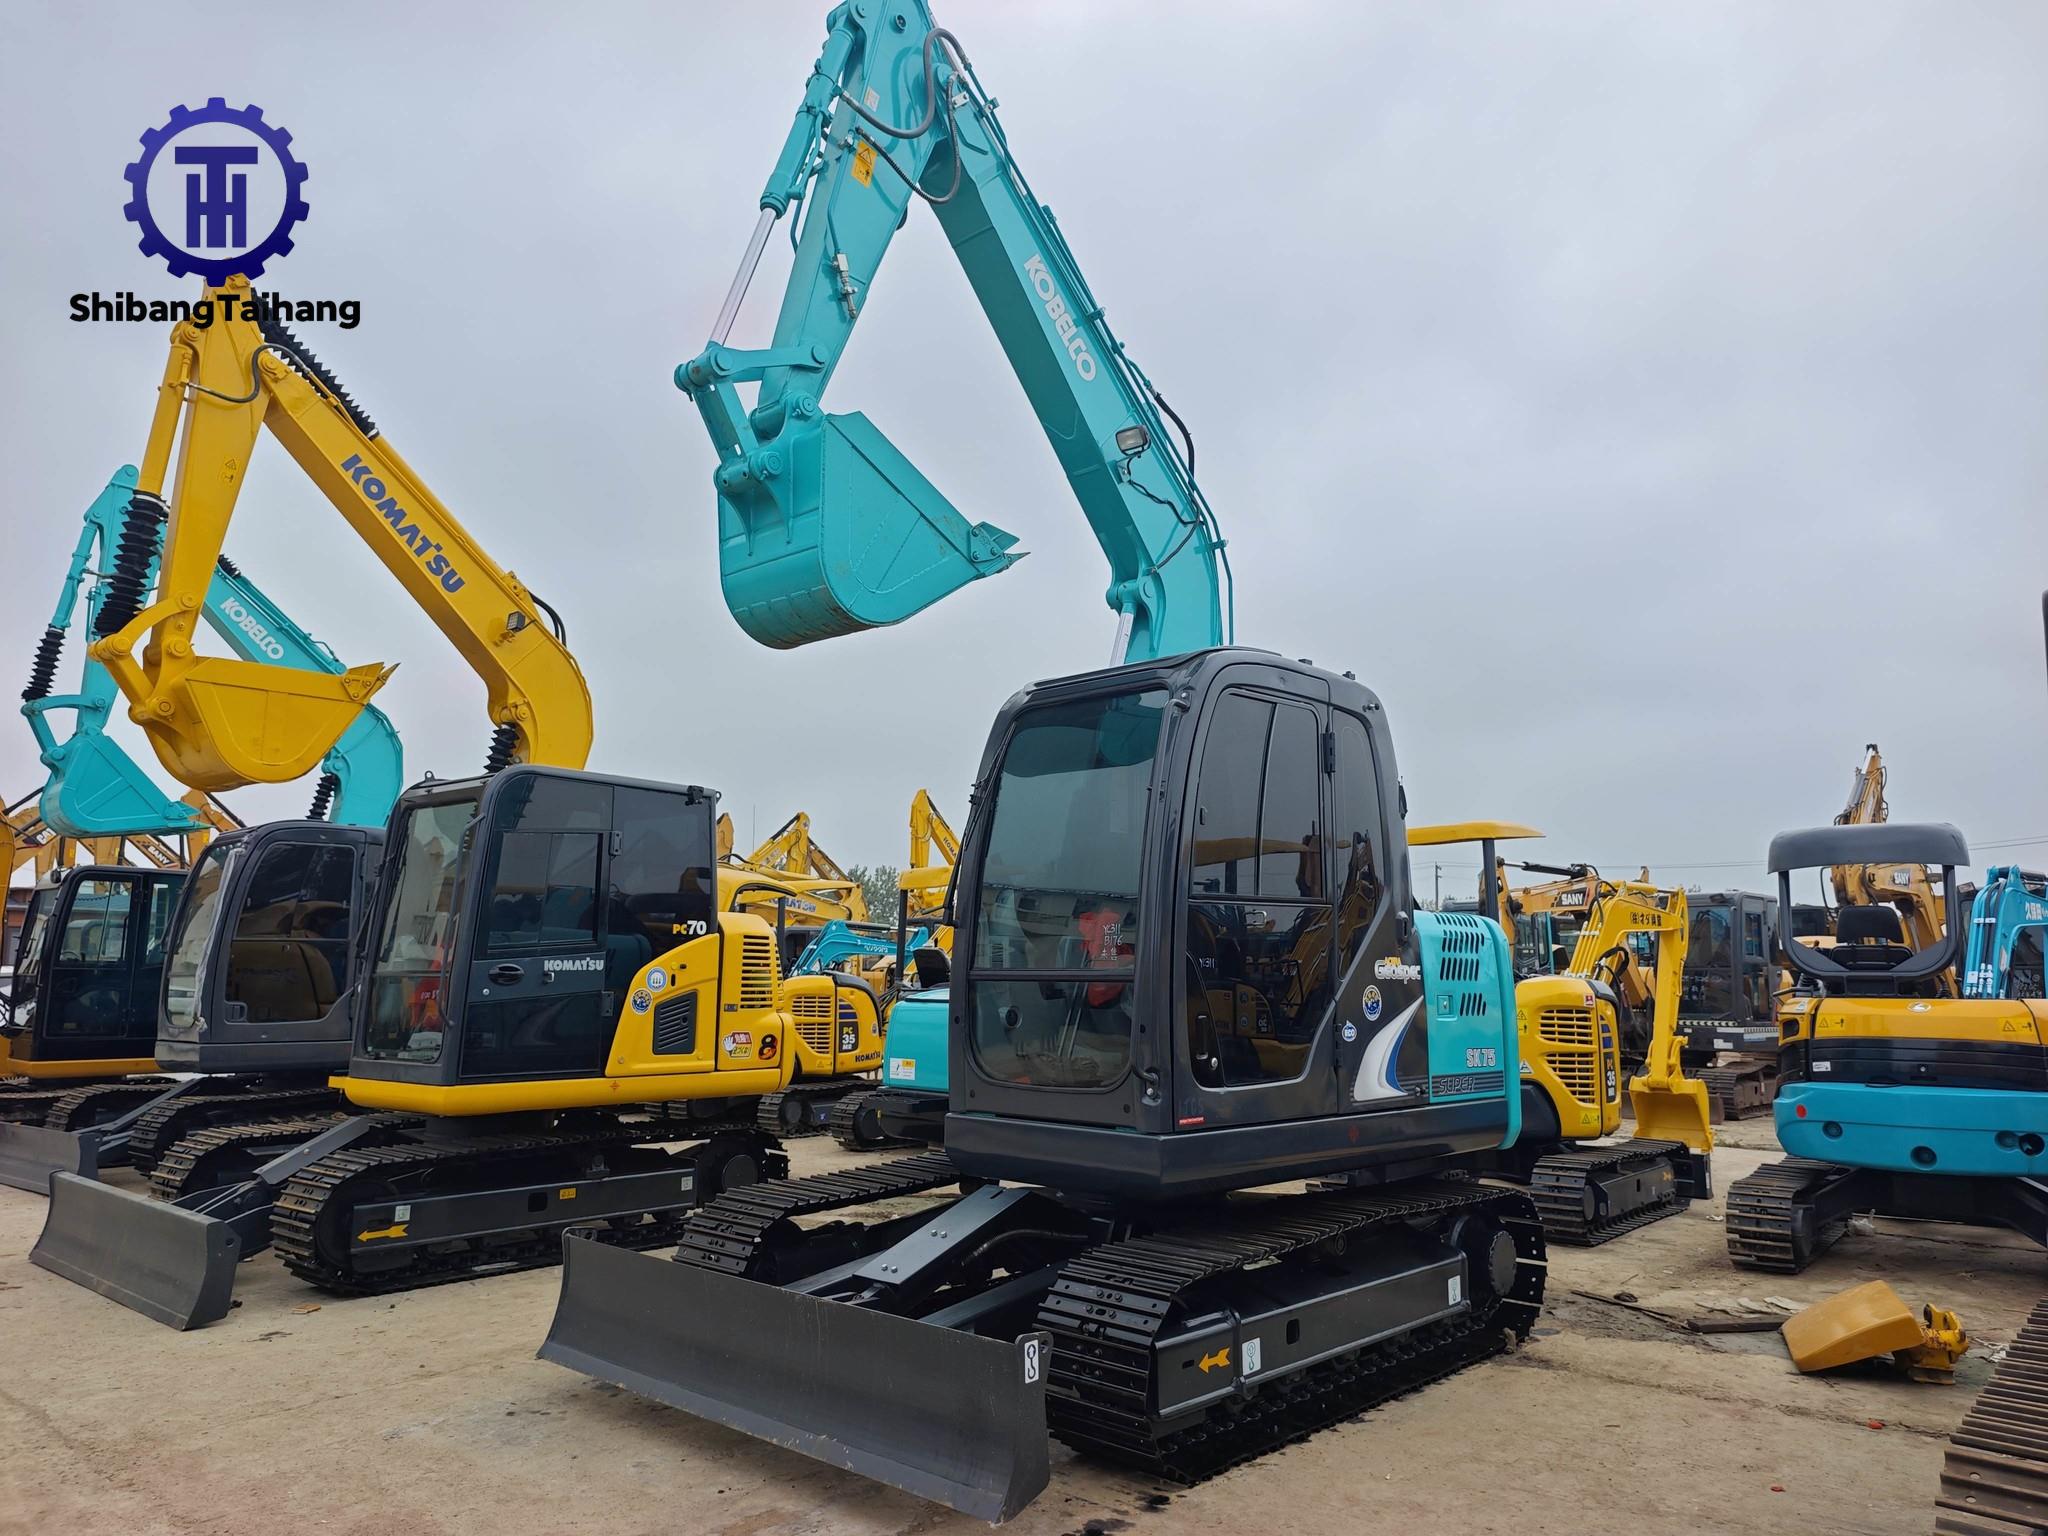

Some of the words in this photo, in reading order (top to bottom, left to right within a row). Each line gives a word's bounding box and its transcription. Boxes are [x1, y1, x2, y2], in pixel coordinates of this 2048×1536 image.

[1023, 253, 1097, 382] KOBELCO
[340, 453, 466, 594] KOMATSU
[220, 596, 284, 660] KOBELCO
[1561, 892, 1584, 906] SANY
[672, 920, 708, 936] PC70
[543, 956, 605, 971] KOMATSU
[1374, 959, 1422, 985] Geospec
[841, 1033, 856, 1044] 35
[1439, 1076, 1476, 1095] SUPER
[1606, 1069, 1616, 1087] 35
